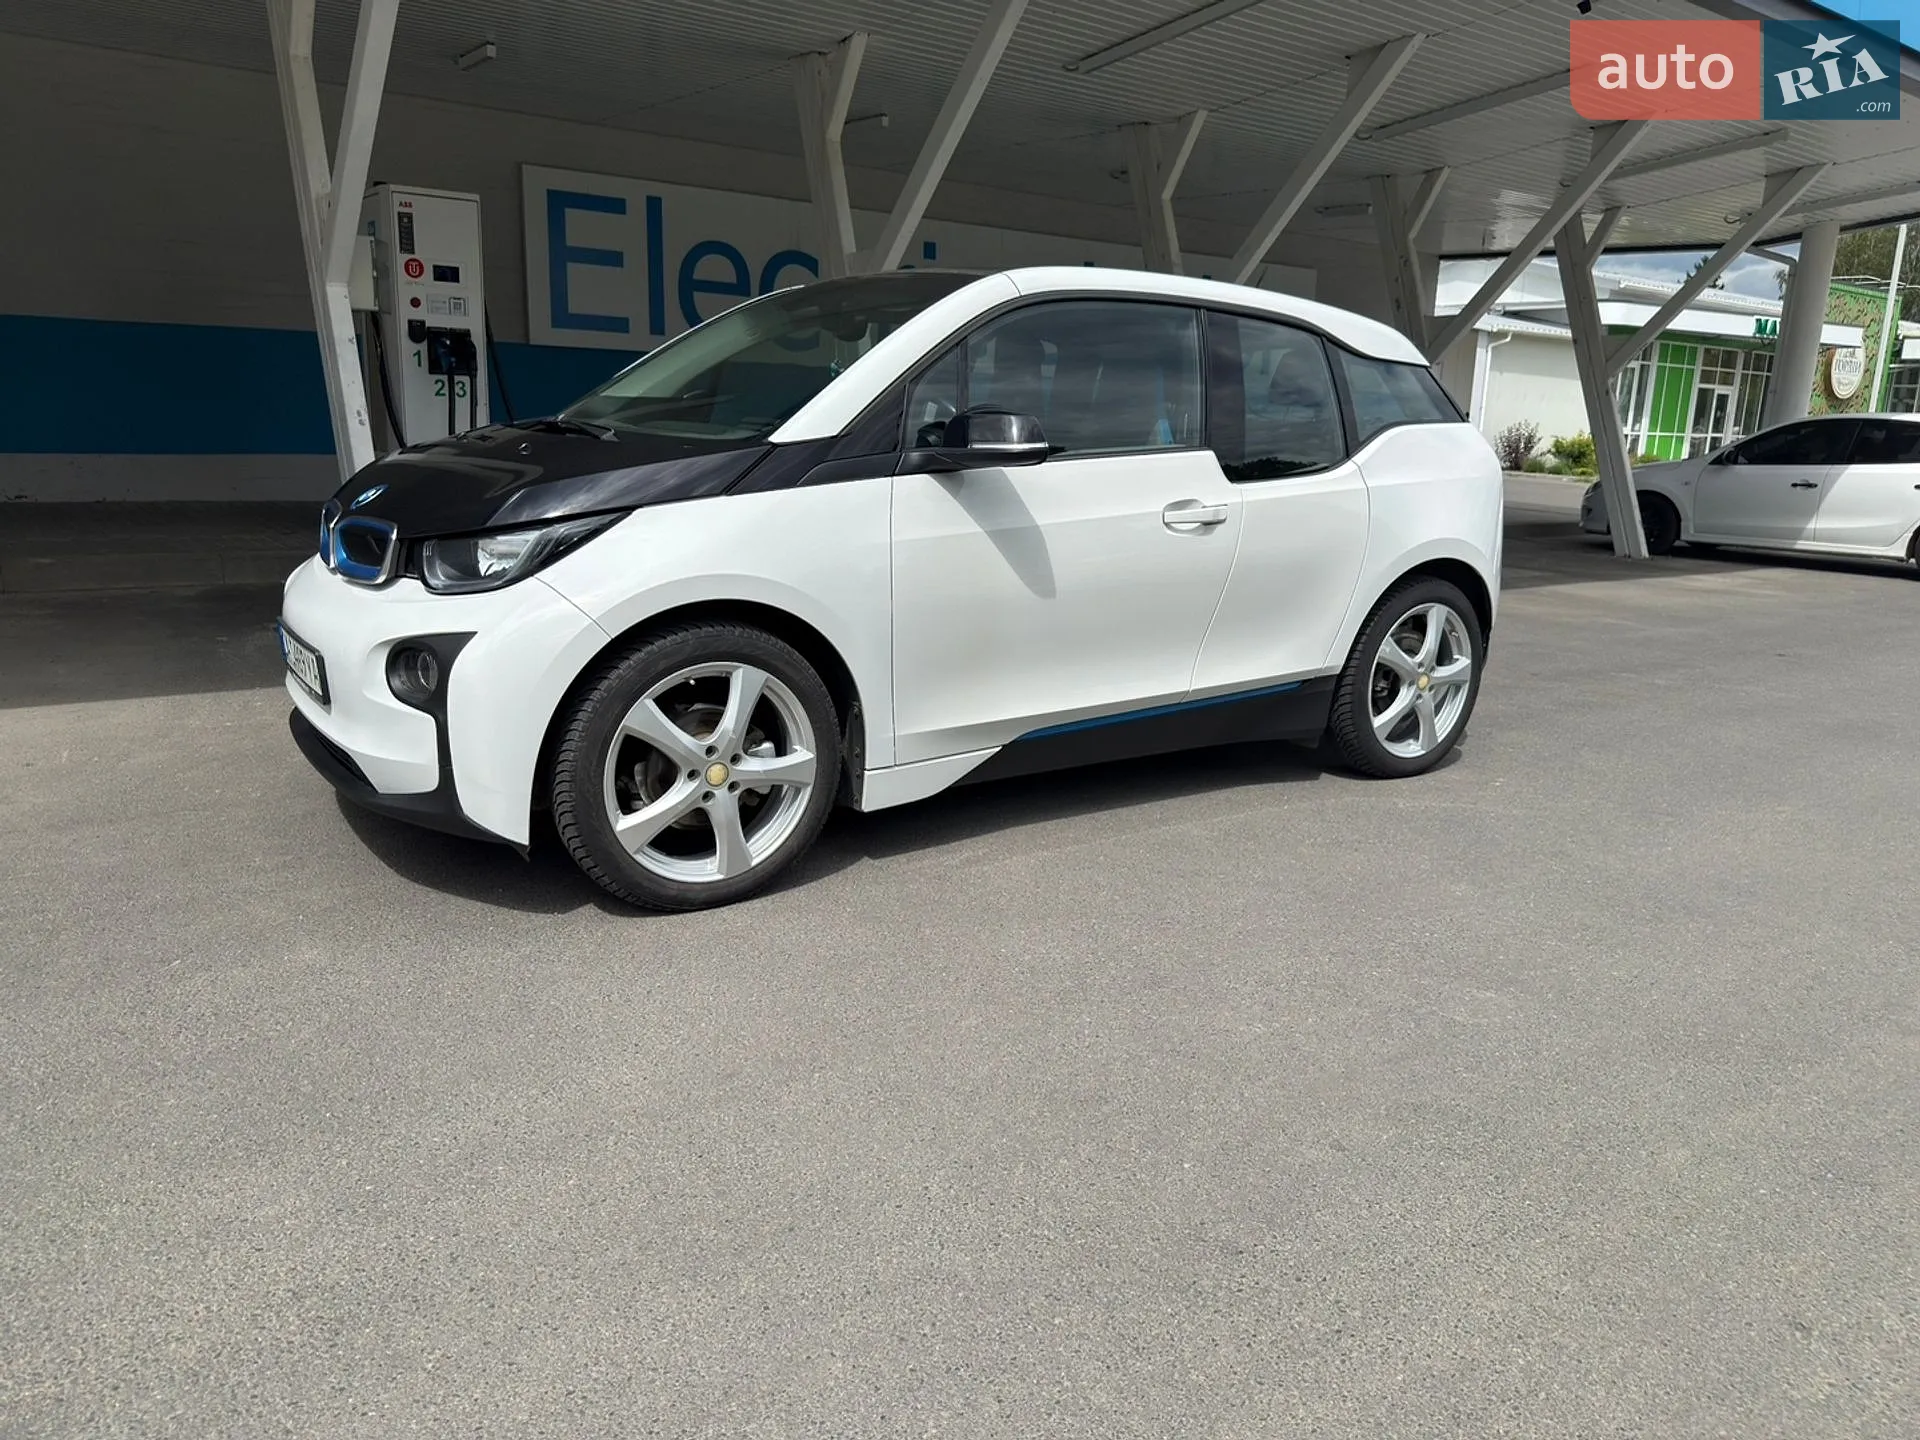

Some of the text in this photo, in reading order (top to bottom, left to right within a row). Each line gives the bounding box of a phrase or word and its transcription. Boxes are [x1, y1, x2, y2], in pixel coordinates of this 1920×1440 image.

[546, 188, 822, 346] Elec
[412, 350, 422, 368] 1
[434, 379, 467, 398] 2 3
